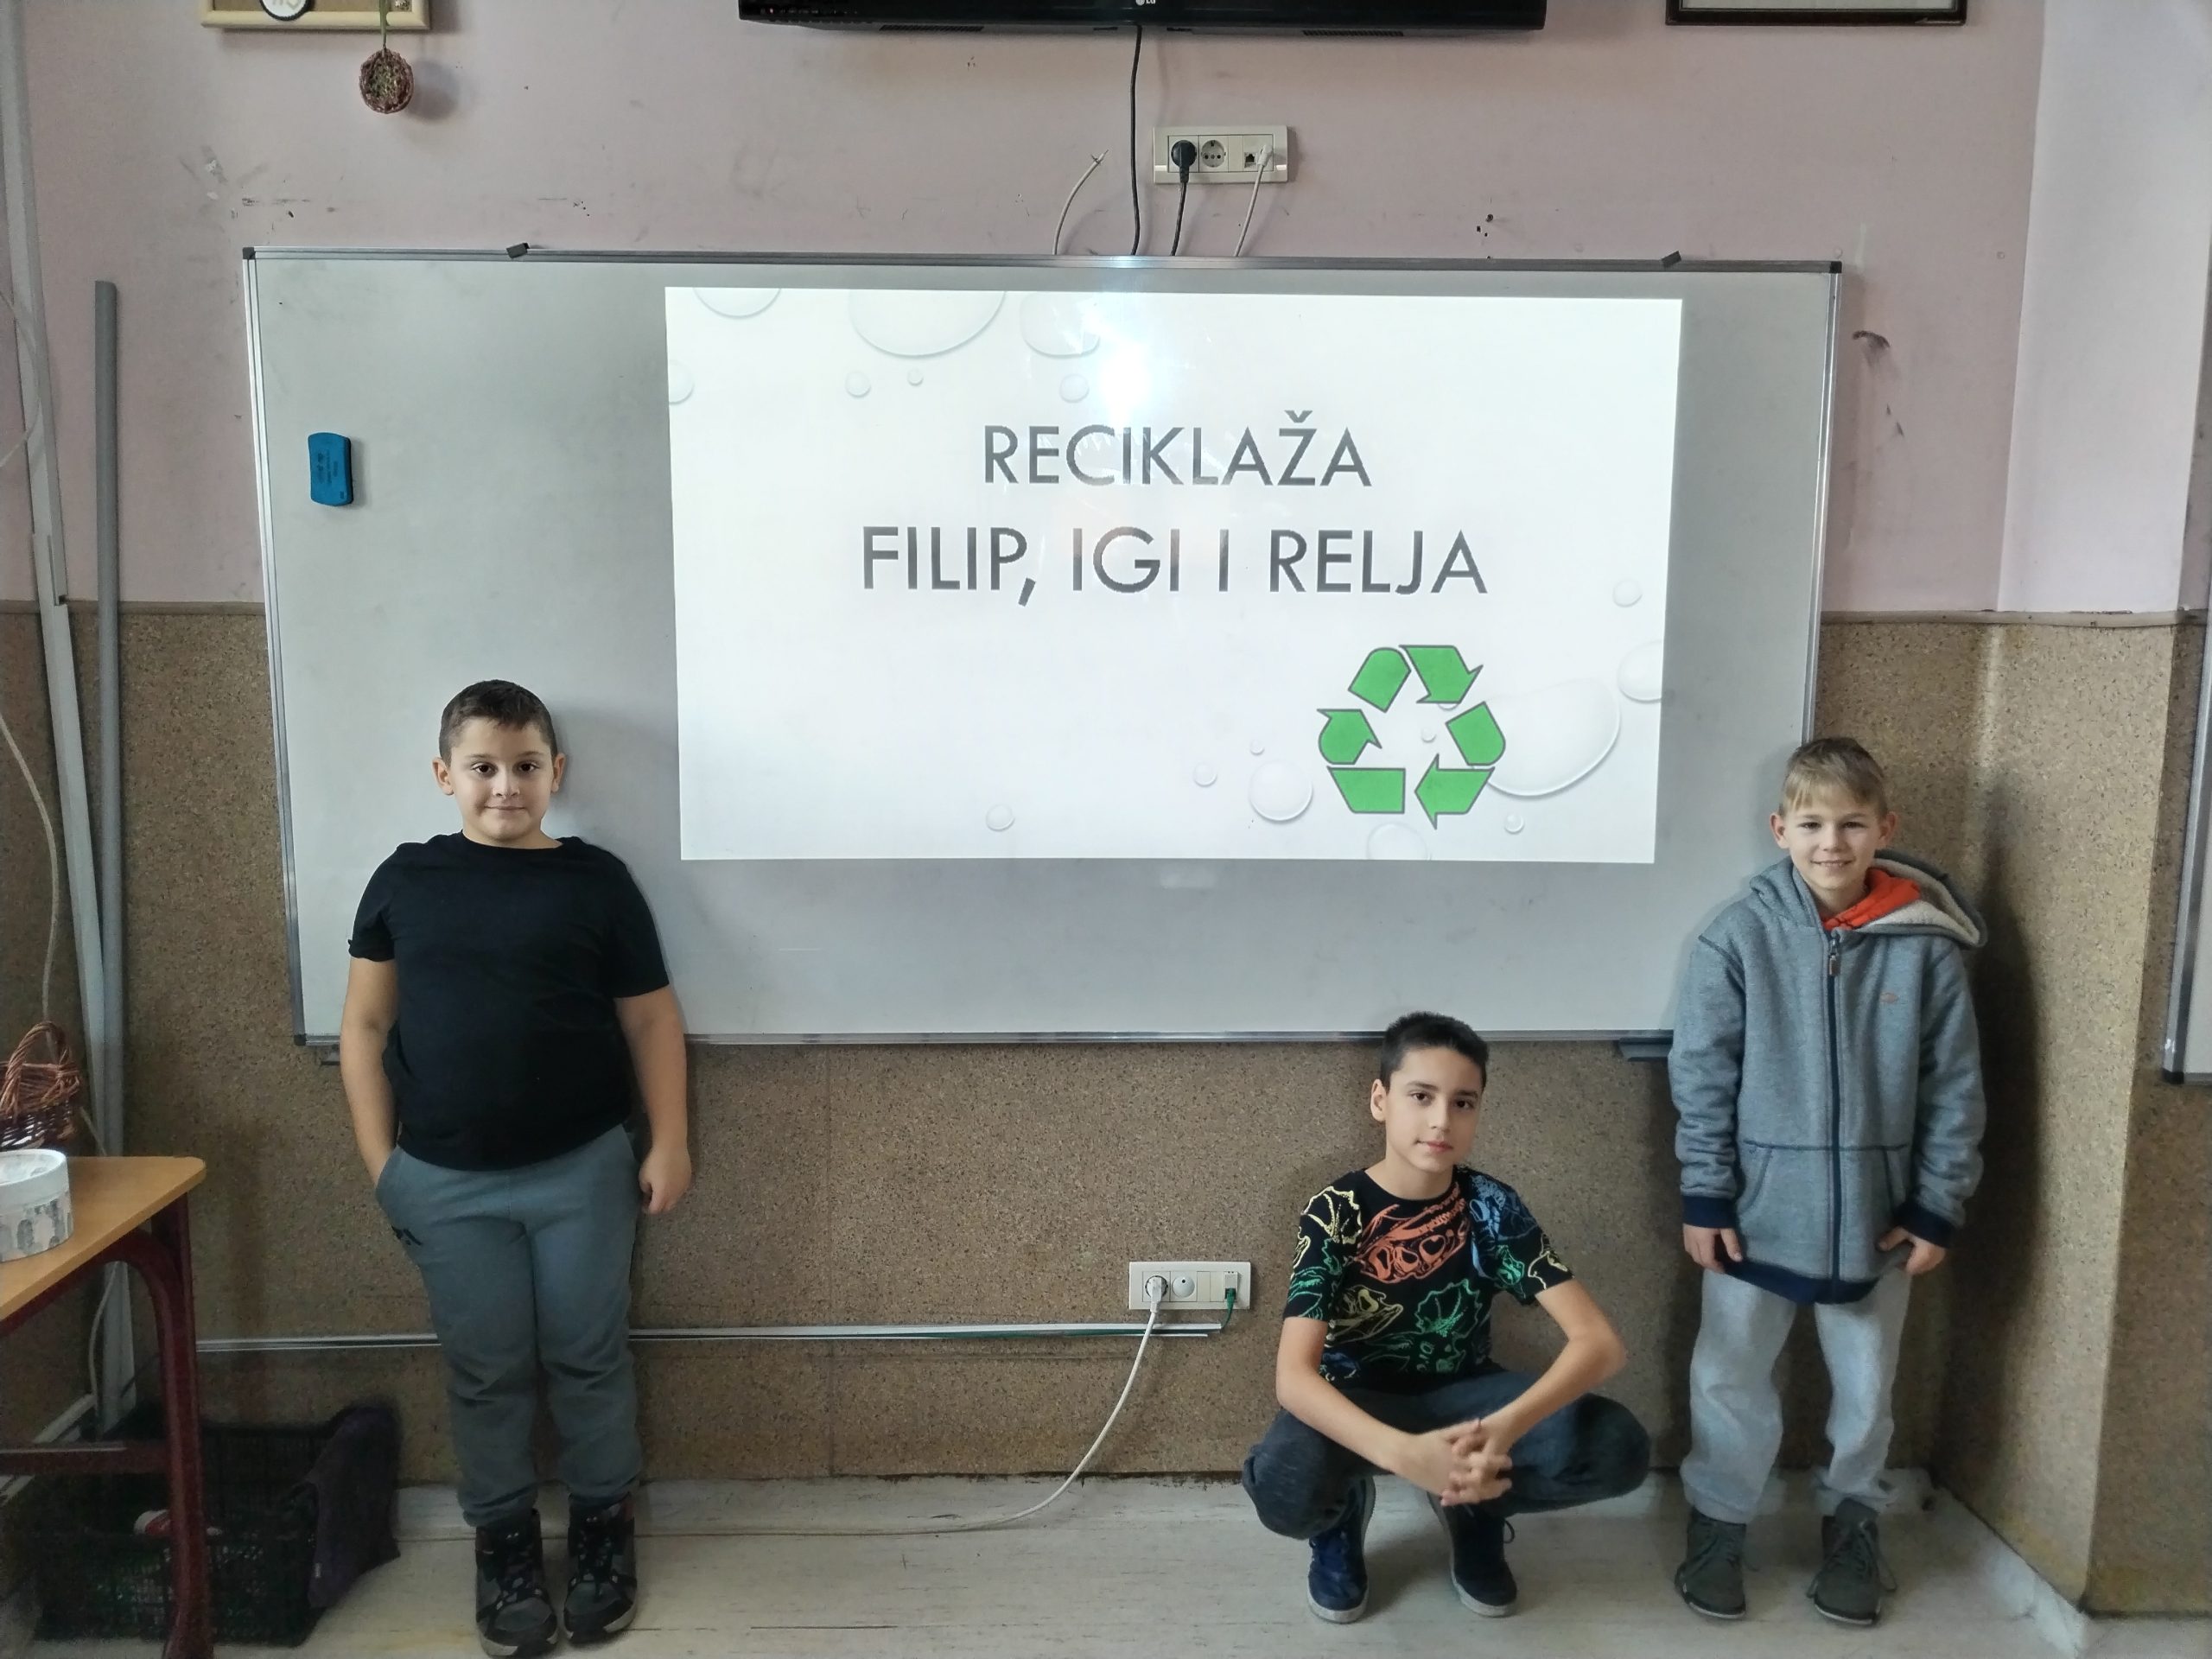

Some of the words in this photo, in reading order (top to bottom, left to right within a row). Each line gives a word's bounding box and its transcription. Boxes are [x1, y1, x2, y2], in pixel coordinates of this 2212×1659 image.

[984, 410, 1373, 486] RECIKLAŽA
[862, 525, 1037, 607] FILIP,
[1072, 525, 1180, 594] IGI
[1218, 528, 1230, 593] I
[1269, 529, 1489, 594] RELJA
